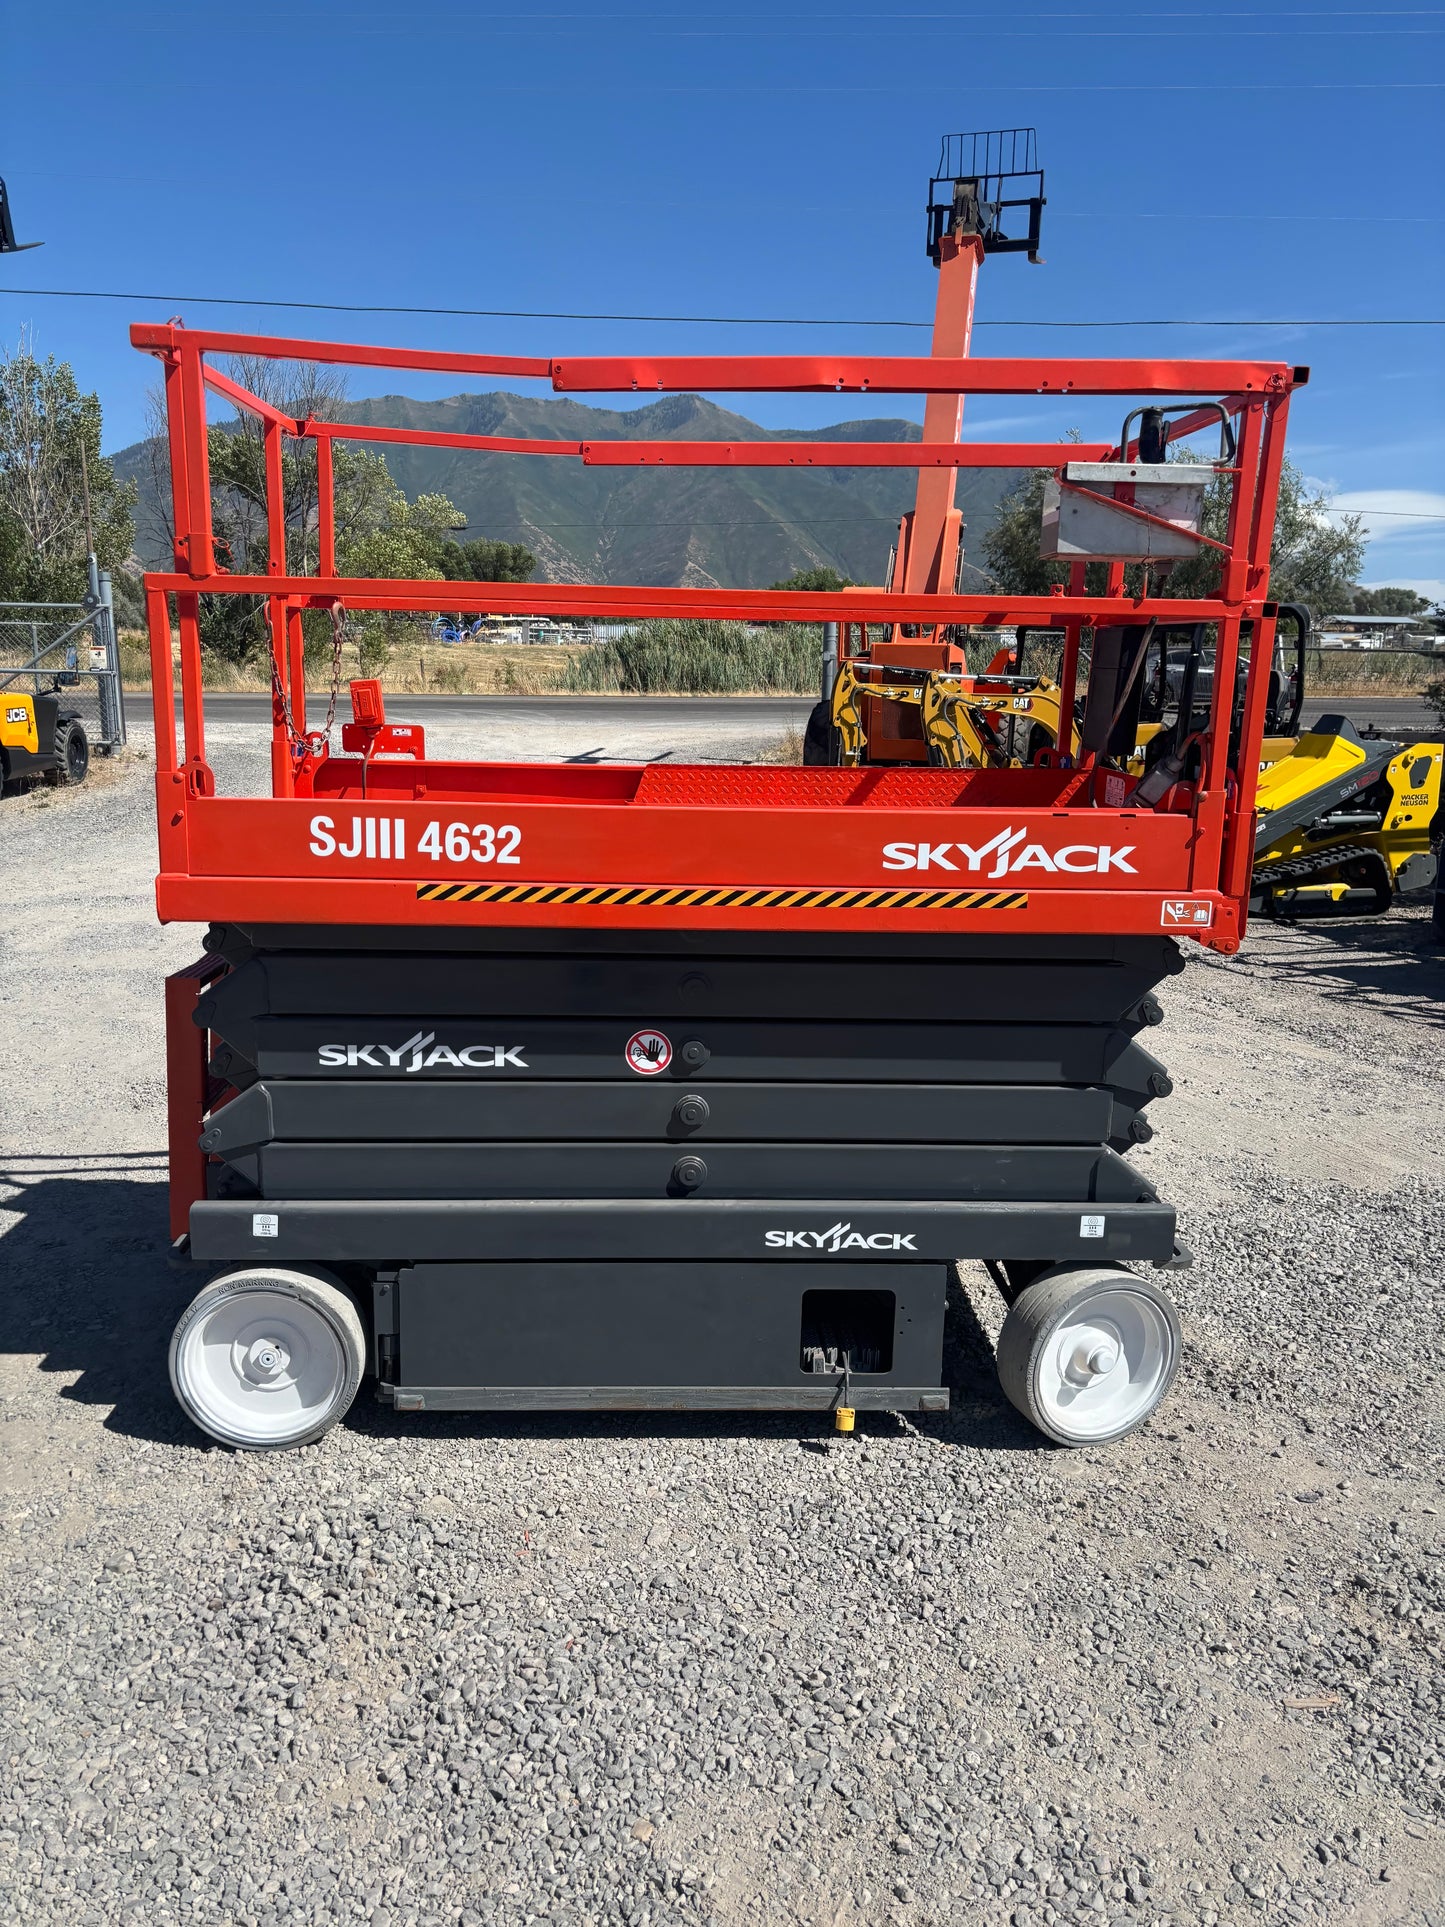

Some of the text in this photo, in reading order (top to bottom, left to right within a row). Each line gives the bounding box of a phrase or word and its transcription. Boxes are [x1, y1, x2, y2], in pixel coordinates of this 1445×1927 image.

[6, 707, 27, 723] JCB
[1013, 698, 1030, 709] CAT
[309, 815, 522, 864] SJIII 4632
[882, 825, 1139, 879] SKYJACK
[318, 1030, 530, 1072] SKYJACK
[765, 1221, 919, 1252] SKYJACK
